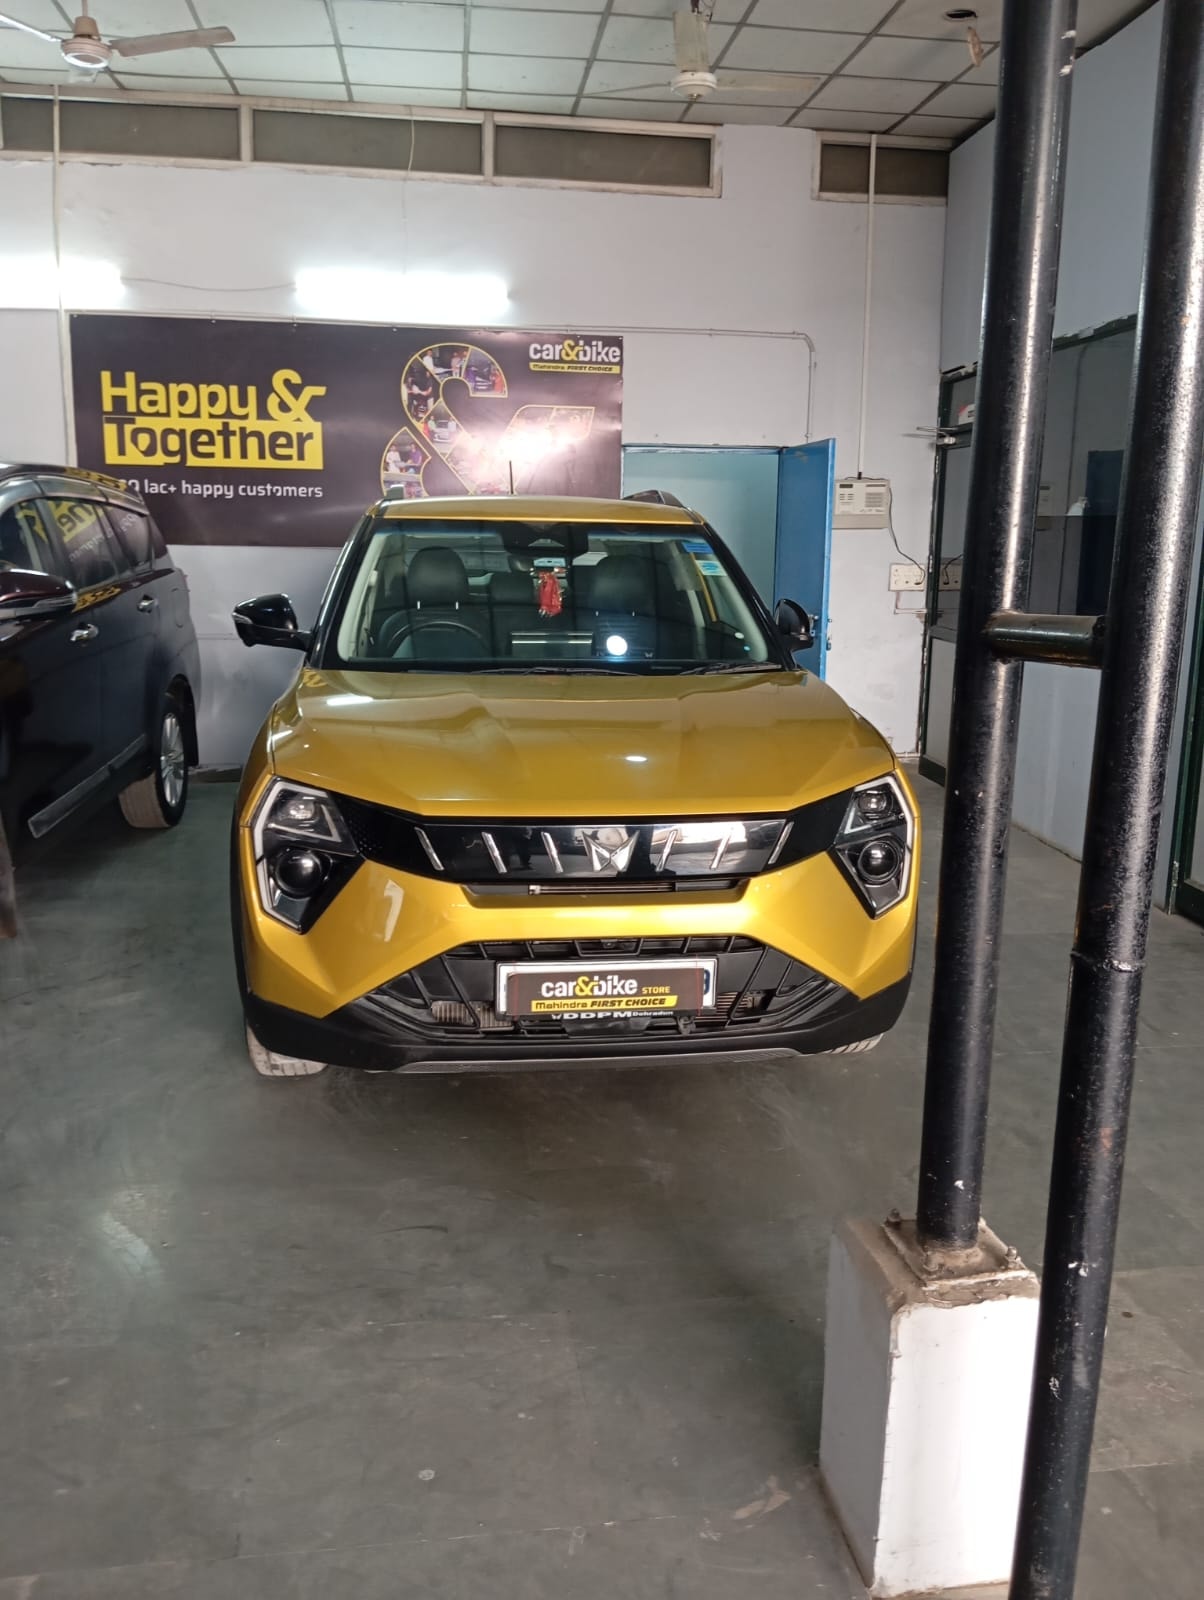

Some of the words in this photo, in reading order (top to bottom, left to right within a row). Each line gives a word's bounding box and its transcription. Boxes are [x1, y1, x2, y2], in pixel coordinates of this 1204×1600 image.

[529, 339, 621, 363] car&bike
[100, 370, 257, 420] Happy
[267, 368, 327, 423] &
[104, 416, 314, 466] Together
[144, 479, 177, 494] lac+
[181, 480, 233, 498] happy
[238, 483, 323, 498] customers
[541, 975, 638, 998] car&bike
[641, 986, 671, 995] STORE
[535, 1001, 588, 1010] Mahindra
[590, 999, 624, 1008] FIRST
[625, 997, 667, 1007] CHOICE
